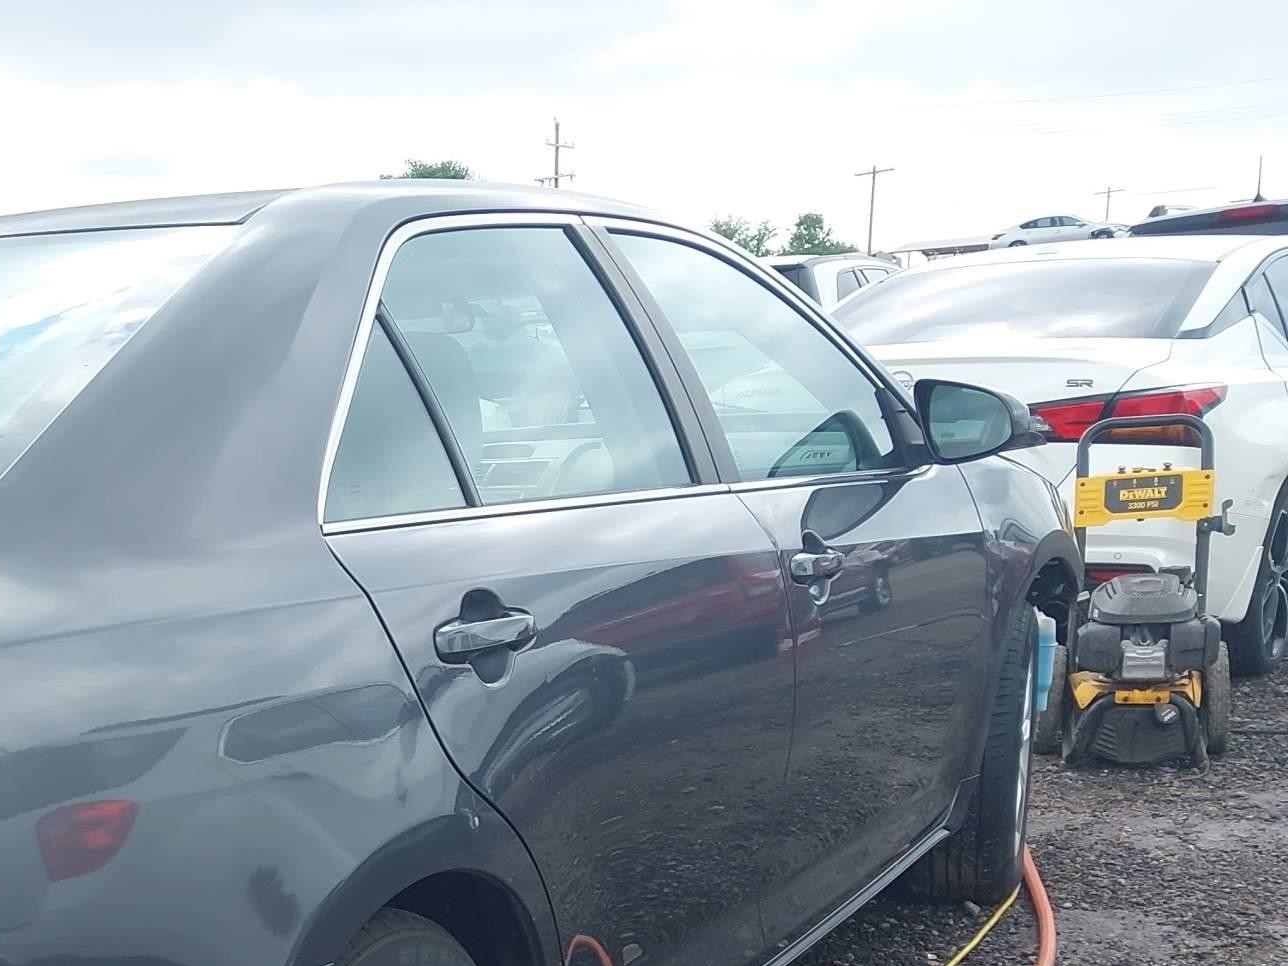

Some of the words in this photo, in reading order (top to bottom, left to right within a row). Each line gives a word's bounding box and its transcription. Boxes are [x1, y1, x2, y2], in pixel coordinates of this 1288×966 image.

[1066, 379, 1093, 387] SR
[1127, 501, 1146, 510] 3300
[1146, 500, 1159, 508] PSI
